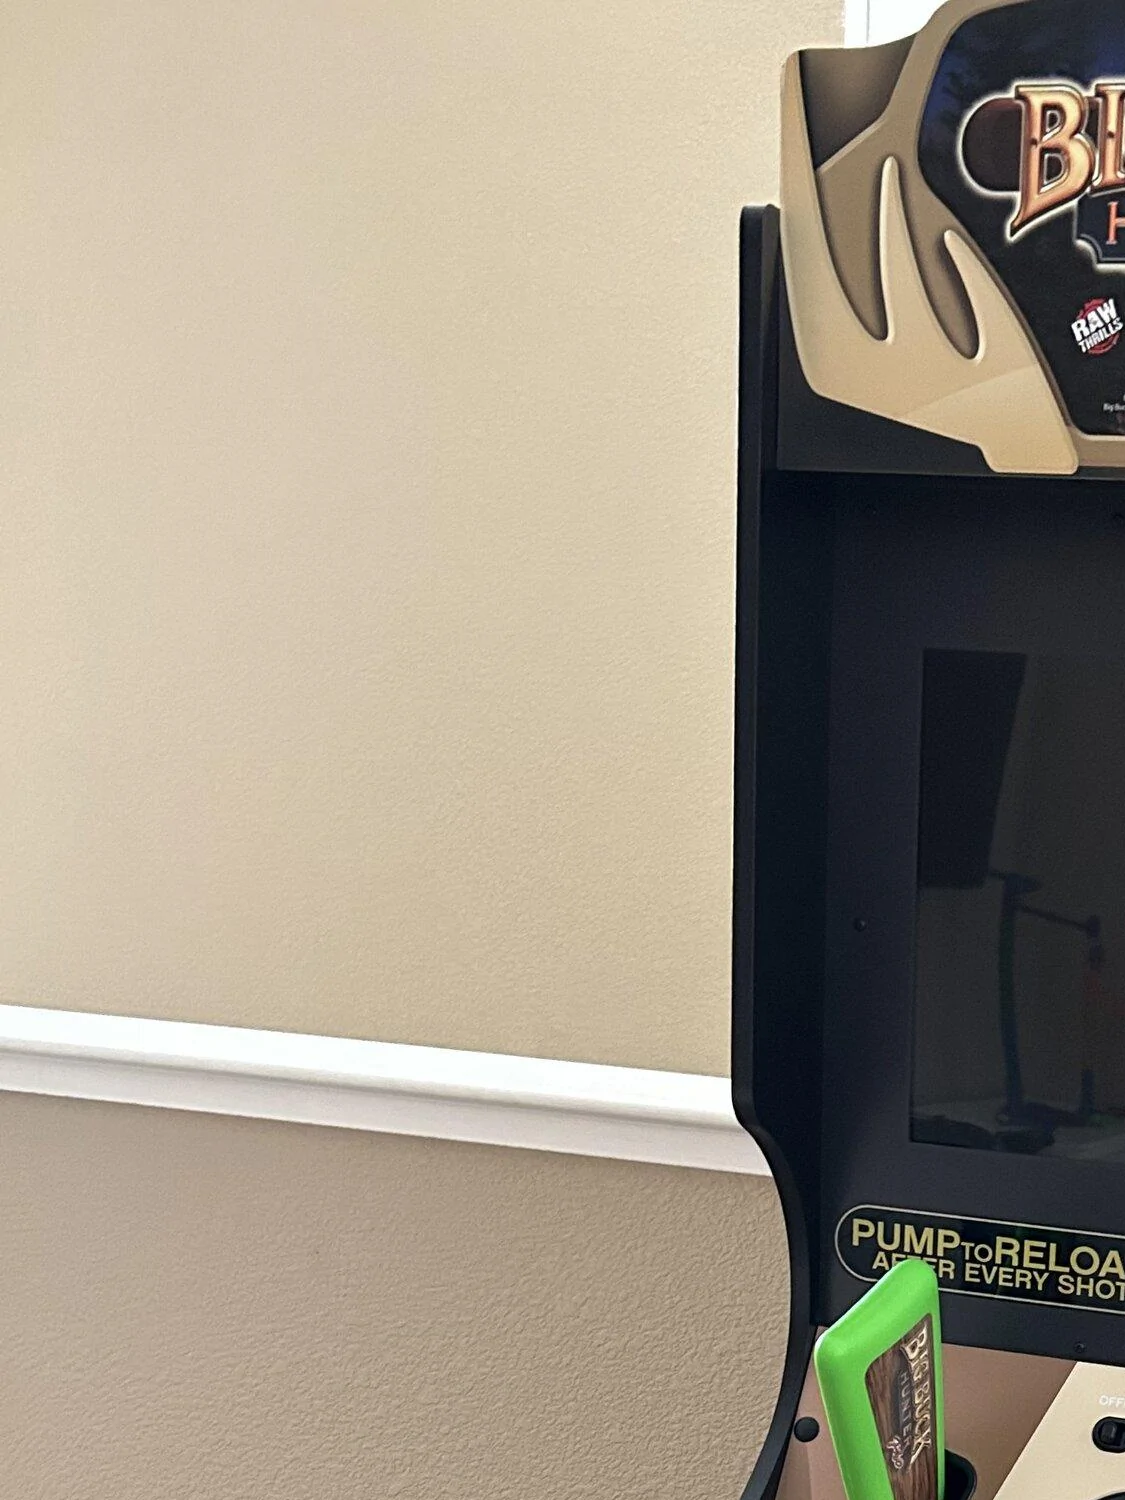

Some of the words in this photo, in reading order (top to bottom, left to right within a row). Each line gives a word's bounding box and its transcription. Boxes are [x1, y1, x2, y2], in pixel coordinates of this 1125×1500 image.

[1071, 298, 1117, 341] RAW
[1079, 317, 1124, 353] THRILLS
[852, 1218, 961, 1258] PUMP
[965, 1264, 1050, 1291] EVERY
[902, 1326, 929, 1382] BIG
[908, 1382, 932, 1466] BUCK
